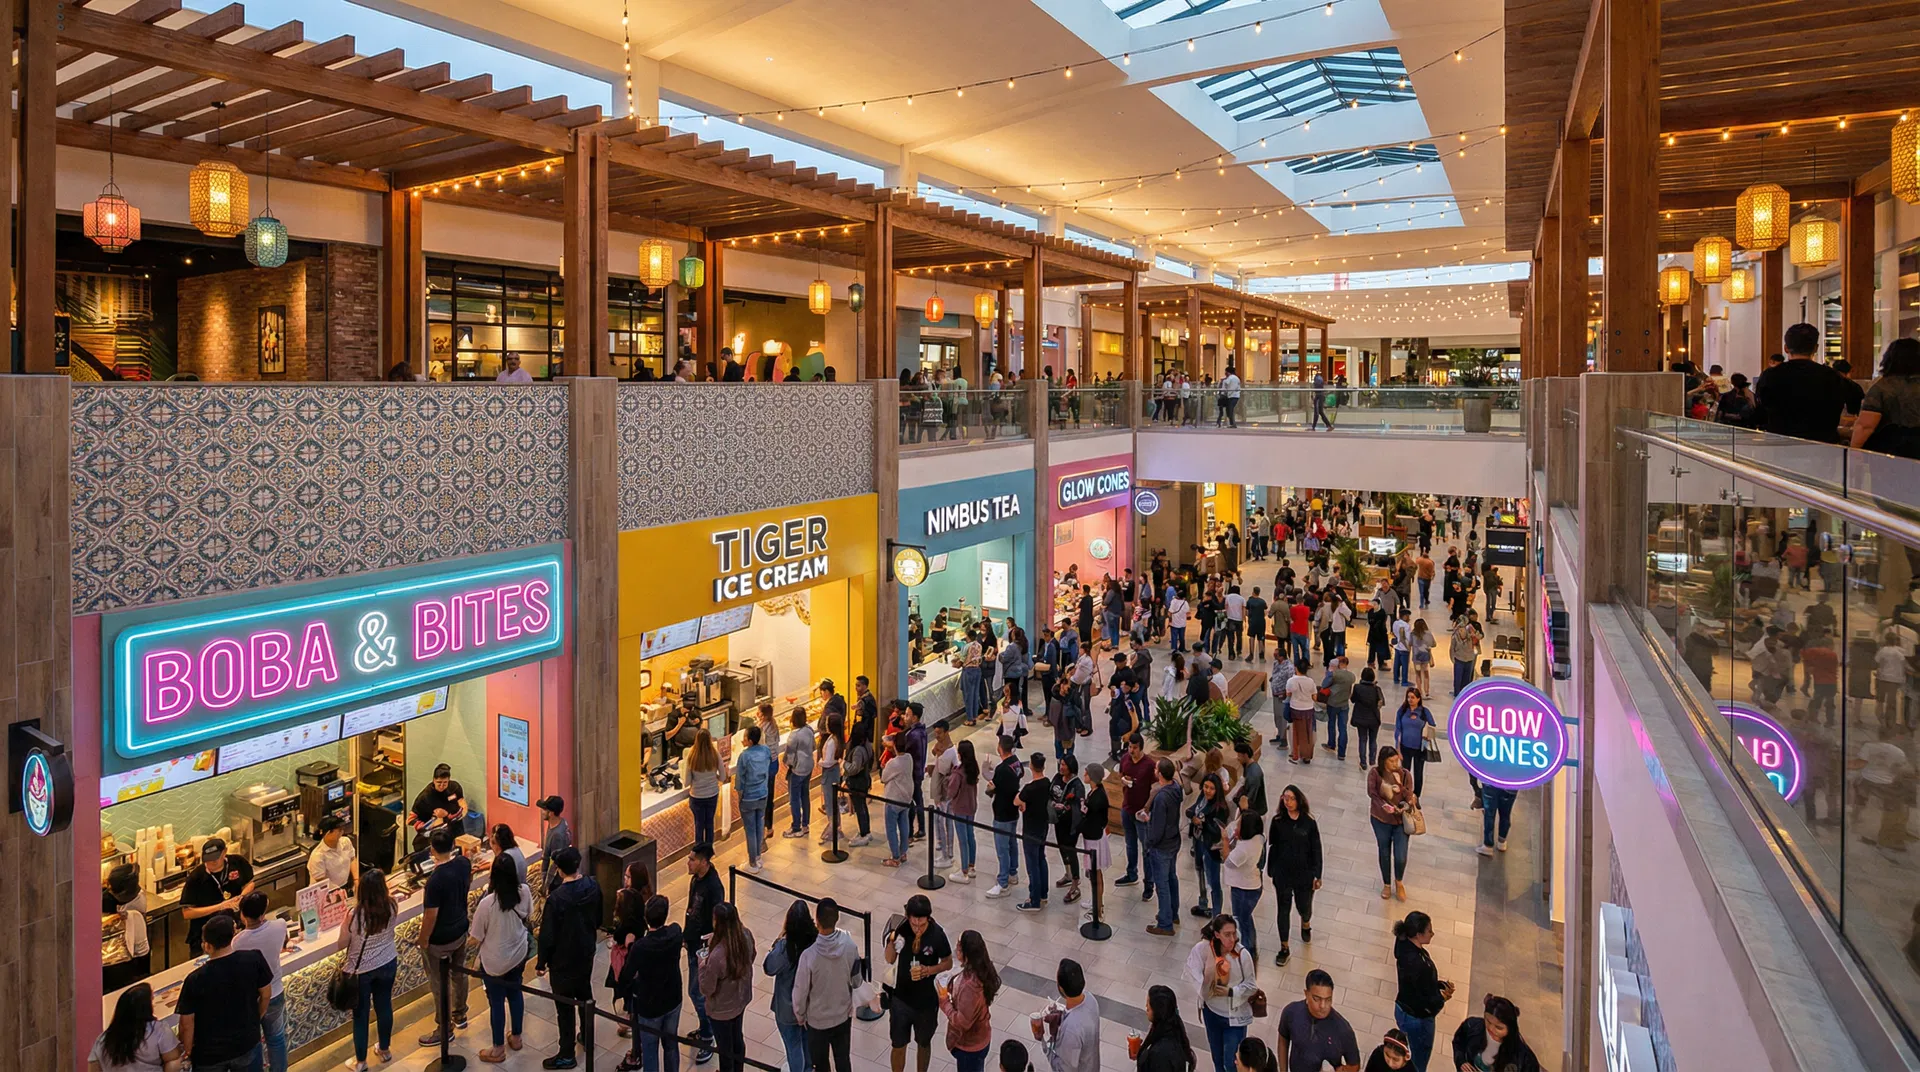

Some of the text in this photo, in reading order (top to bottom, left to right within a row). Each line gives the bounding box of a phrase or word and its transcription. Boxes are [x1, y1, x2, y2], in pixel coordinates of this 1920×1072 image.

[1062, 471, 1130, 502] GLOW CONES
[926, 493, 1020, 536] NIMBUS TEA
[712, 515, 828, 573] TIGER
[713, 555, 828, 602] ICE CREAM
[144, 621, 339, 724] BOBA
[353, 610, 397, 674] &
[413, 579, 551, 661] BITES
[1469, 704, 1544, 738] GLOW
[1464, 732, 1549, 769] CONES
